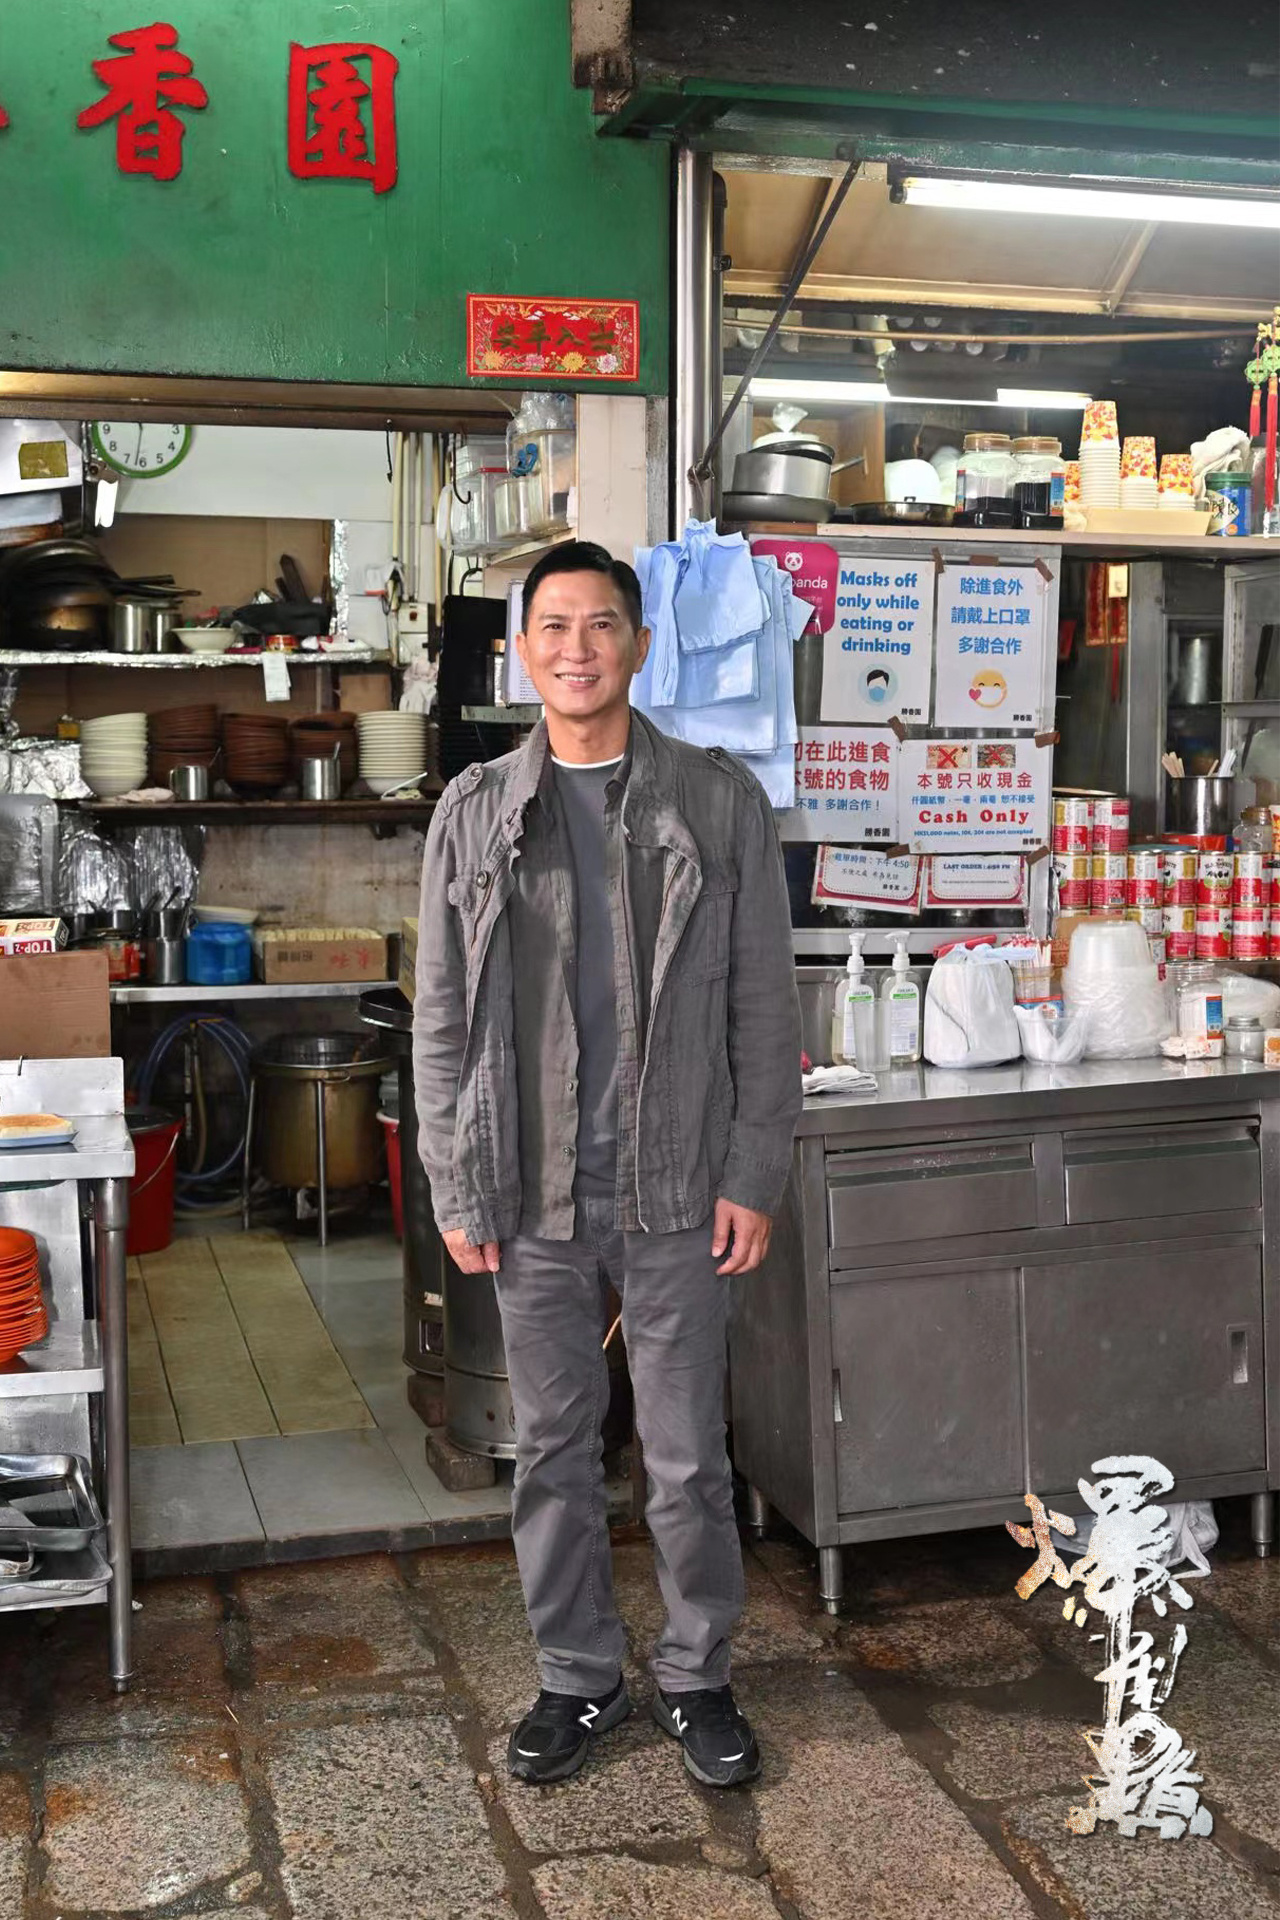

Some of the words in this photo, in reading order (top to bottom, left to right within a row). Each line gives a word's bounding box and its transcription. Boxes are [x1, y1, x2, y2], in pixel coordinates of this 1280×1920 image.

[0, 22, 399, 195] 香園
[103, 424, 111, 434] 9
[172, 424, 180, 435] 3
[109, 441, 117, 452] 8
[168, 441, 175, 452] 4
[124, 453, 131, 464] 7
[139, 457, 147, 468] 6
[156, 453, 164, 464] 5
[840, 570, 890, 587] Masks
[894, 572, 918, 588] off
[960, 577, 1024, 596] 除進食外
[836, 593, 871, 611] only
[875, 595, 920, 610] while
[951, 606, 1031, 625] 請戴上口罩
[840, 616, 893, 633] eating
[897, 619, 915, 631] or
[841, 636, 911, 655] drinking
[958, 636, 1022, 655] 多謝合作
[917, 772, 1032, 790] 本號只收現金
[918, 809, 968, 824] Cash
[979, 809, 1030, 824] Only
[864, 827, 891, 837] 勝香園
